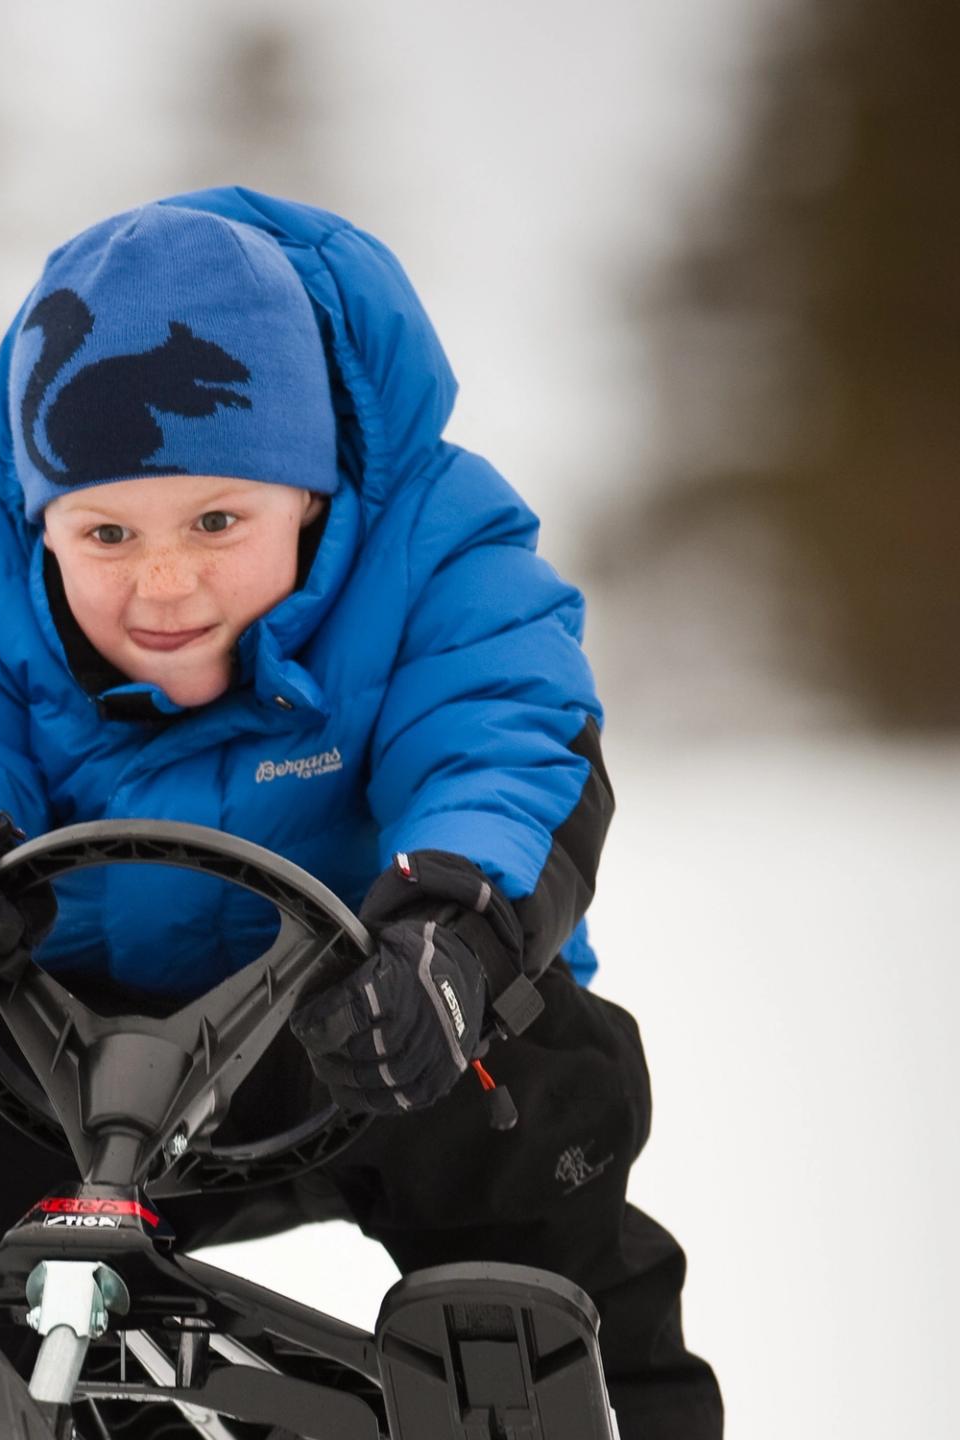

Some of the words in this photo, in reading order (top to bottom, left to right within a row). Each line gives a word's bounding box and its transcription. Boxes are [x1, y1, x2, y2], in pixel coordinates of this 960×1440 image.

[255, 746, 341, 784] Bergans
[440, 980, 466, 1039] HESTRA
[46, 1214, 117, 1228] STIGA
